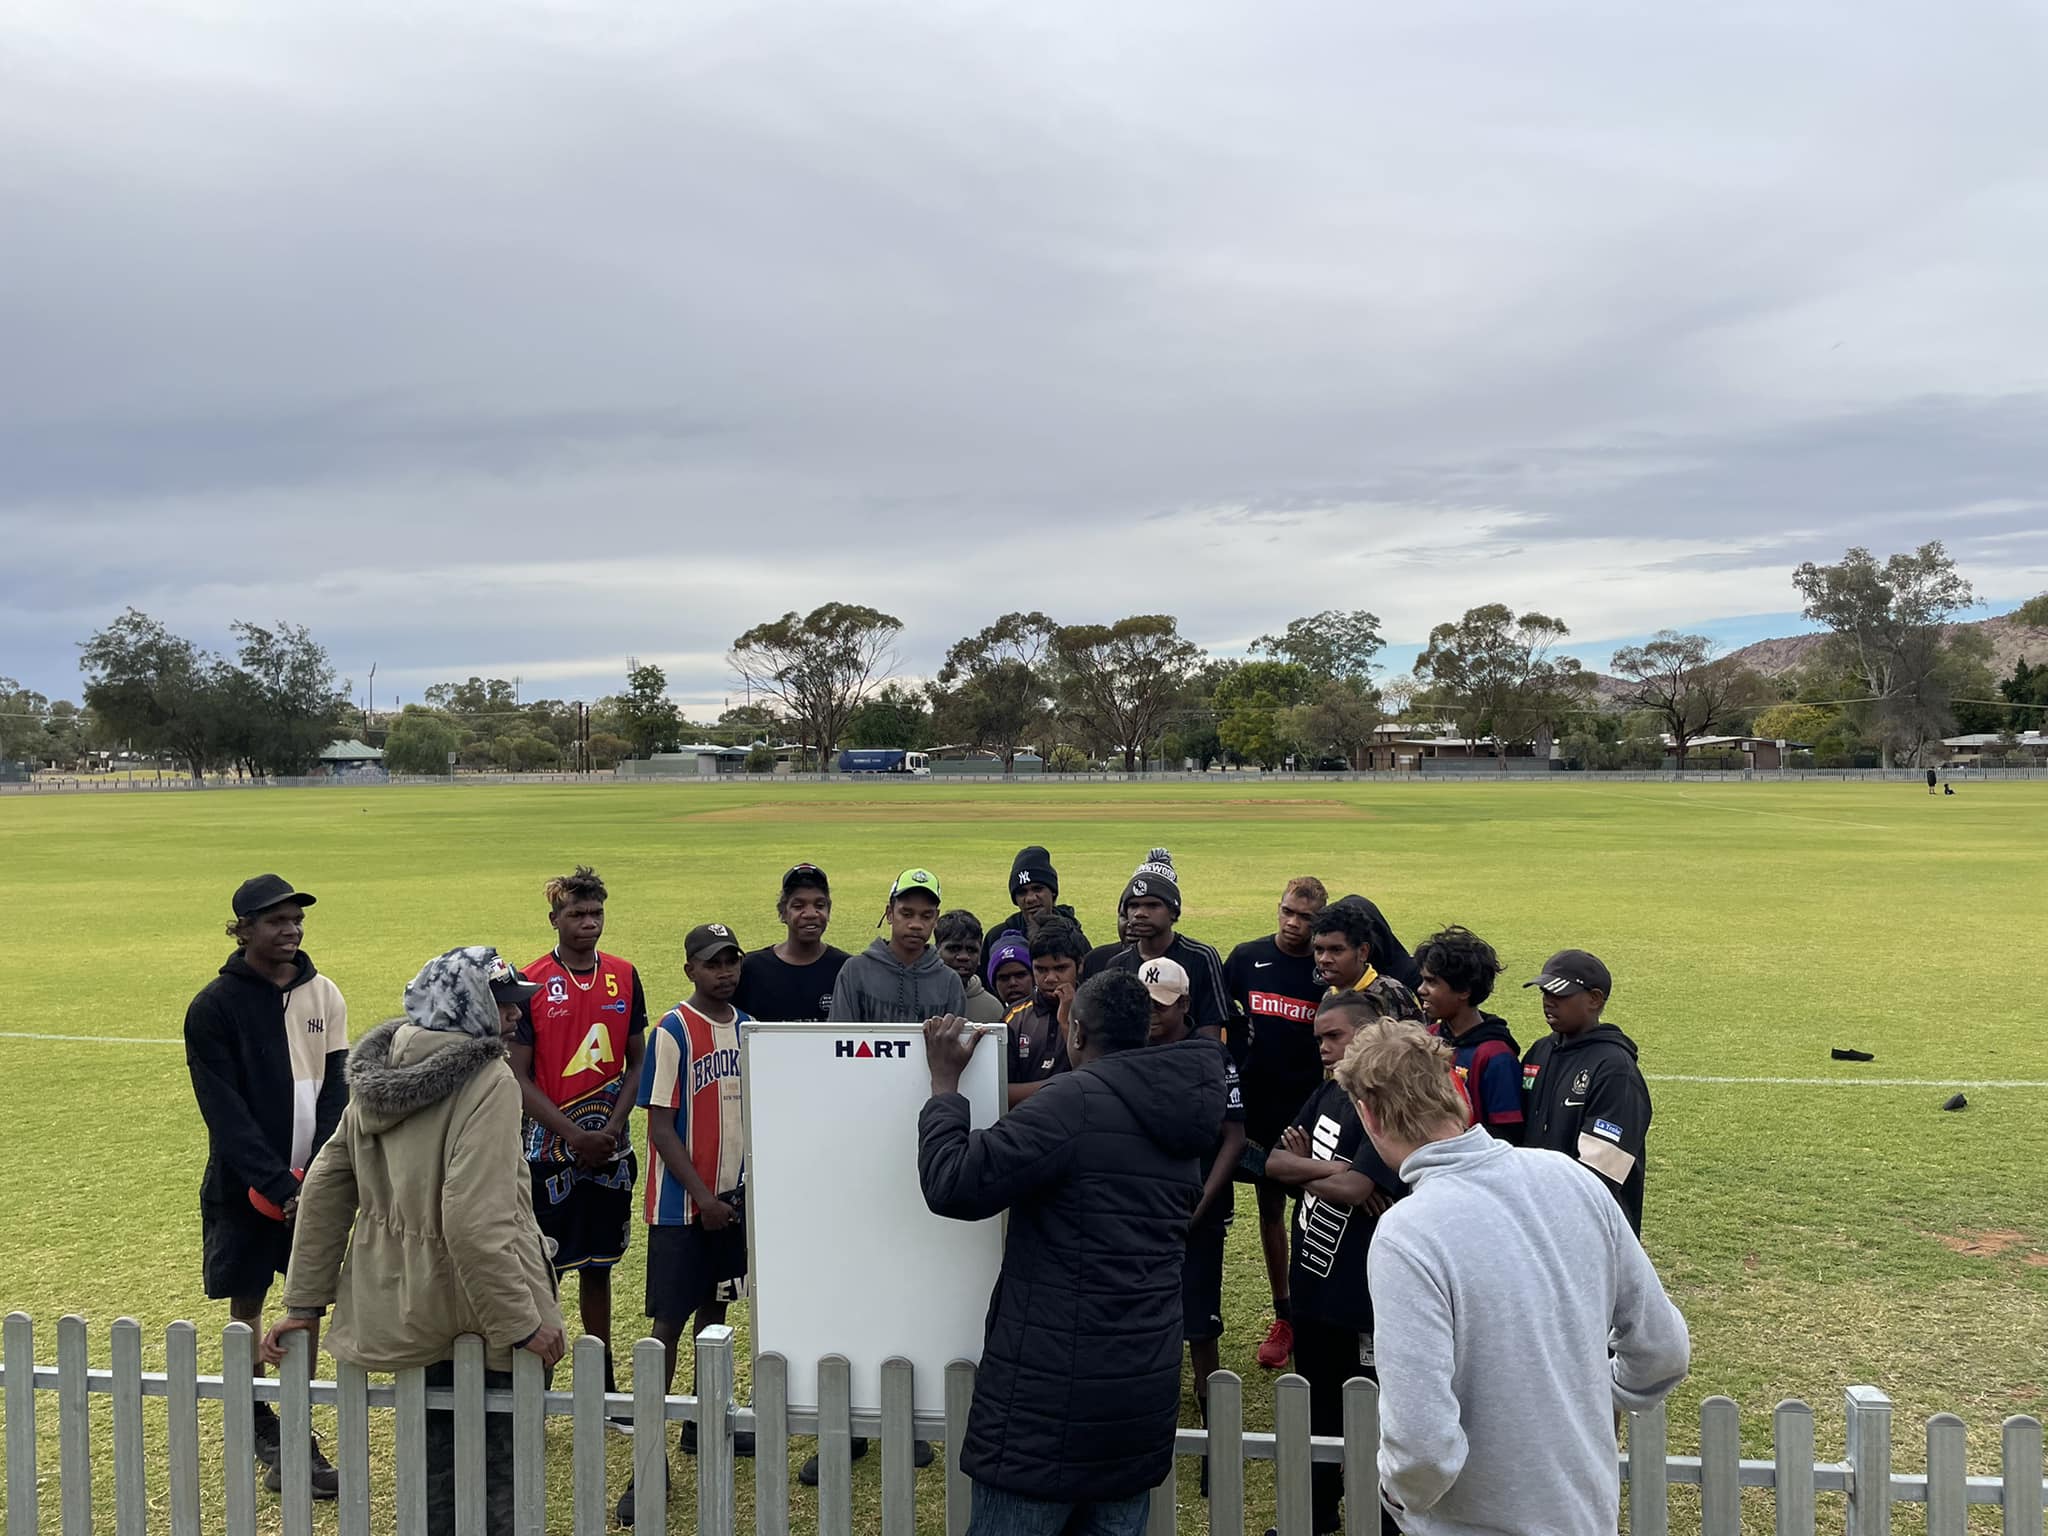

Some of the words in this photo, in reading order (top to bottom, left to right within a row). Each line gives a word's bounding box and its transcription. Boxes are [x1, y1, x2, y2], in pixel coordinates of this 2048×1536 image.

[604, 973, 618, 997] 5
[1251, 994, 1316, 1020] Emirate
[836, 1040, 911, 1058] HART
[693, 1049, 741, 1094] BROOK
